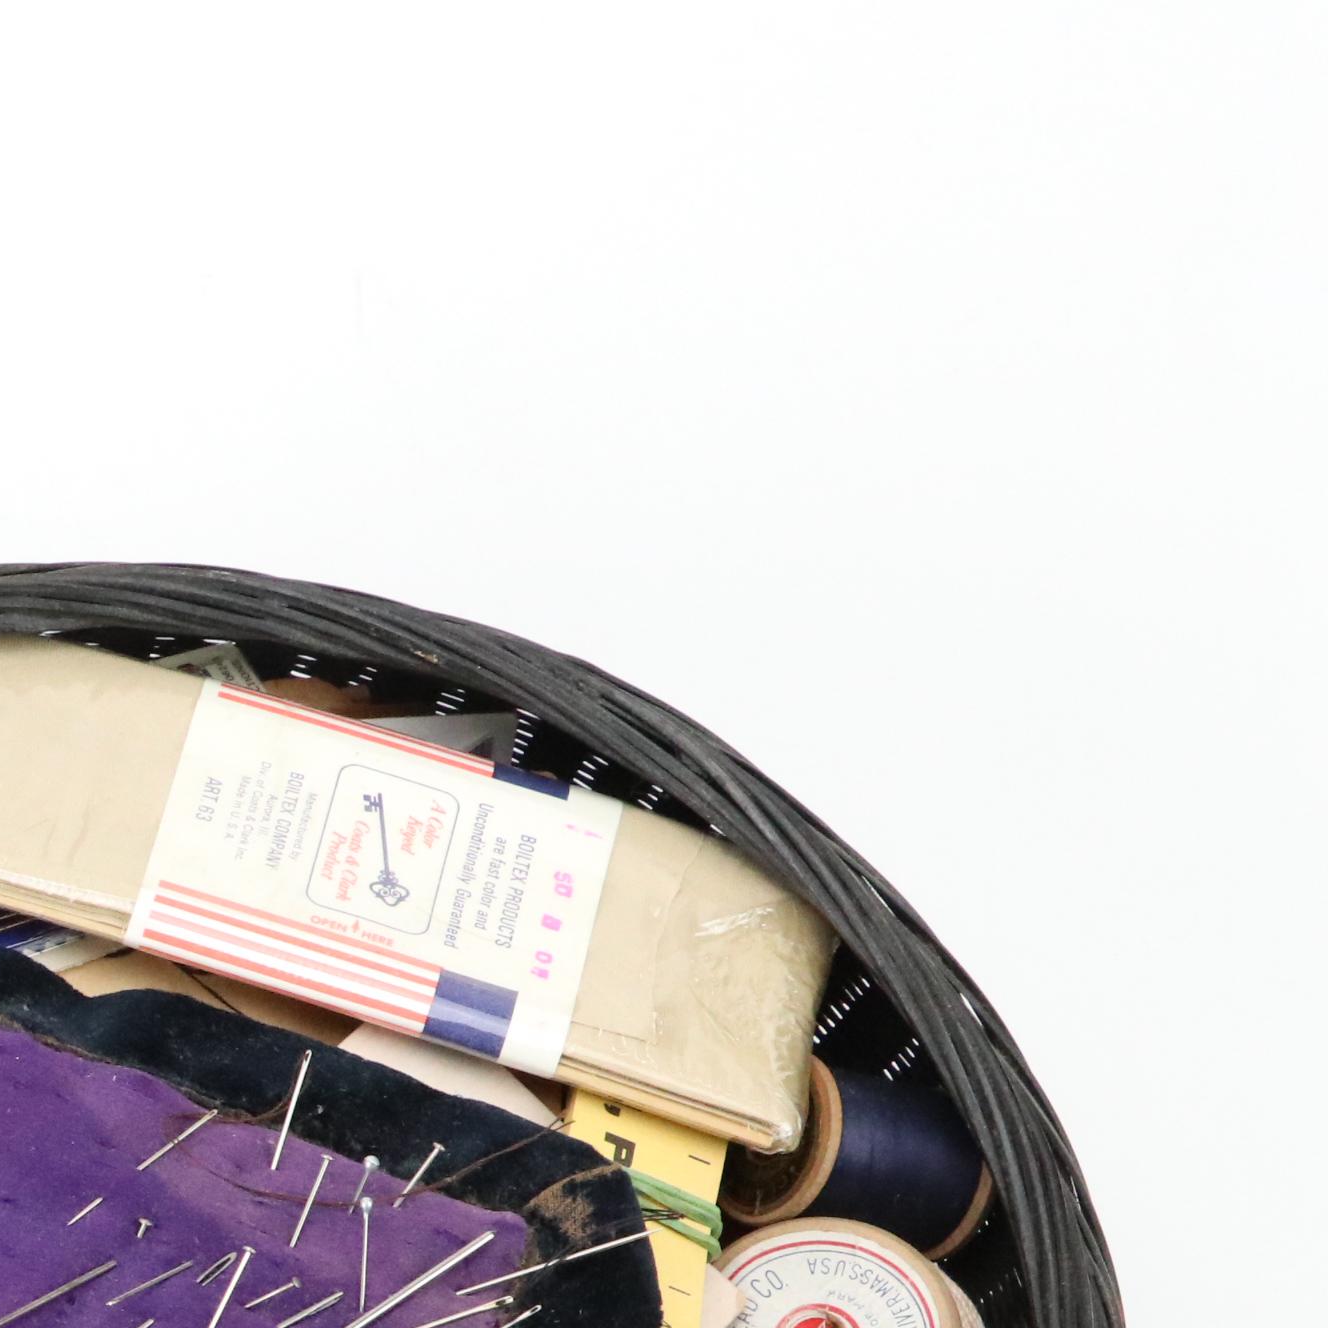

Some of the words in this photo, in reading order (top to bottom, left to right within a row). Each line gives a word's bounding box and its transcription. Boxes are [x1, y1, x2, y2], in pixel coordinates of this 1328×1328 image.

[279, 771, 304, 816] BOILTEX
[429, 799, 447, 815] A
[194, 804, 214, 823] 63
[263, 817, 291, 870] COMPANY
[347, 819, 370, 855] Coats
[398, 814, 423, 855] Keyed
[421, 815, 444, 850] Color
[456, 801, 494, 886] Unconditionally
[492, 836, 506, 855] are
[319, 830, 346, 881] Product
[343, 855, 361, 868] &
[486, 856, 504, 880] fast
[508, 833, 536, 884] BOILTEX
[334, 868, 358, 903] Clark
[478, 880, 498, 908] color
[308, 914, 349, 933] OPEN
[360, 929, 394, 947] HERE
[442, 887, 471, 949] Guaranteed
[473, 909, 491, 930] and
[493, 885, 524, 949] PRODUCTS
